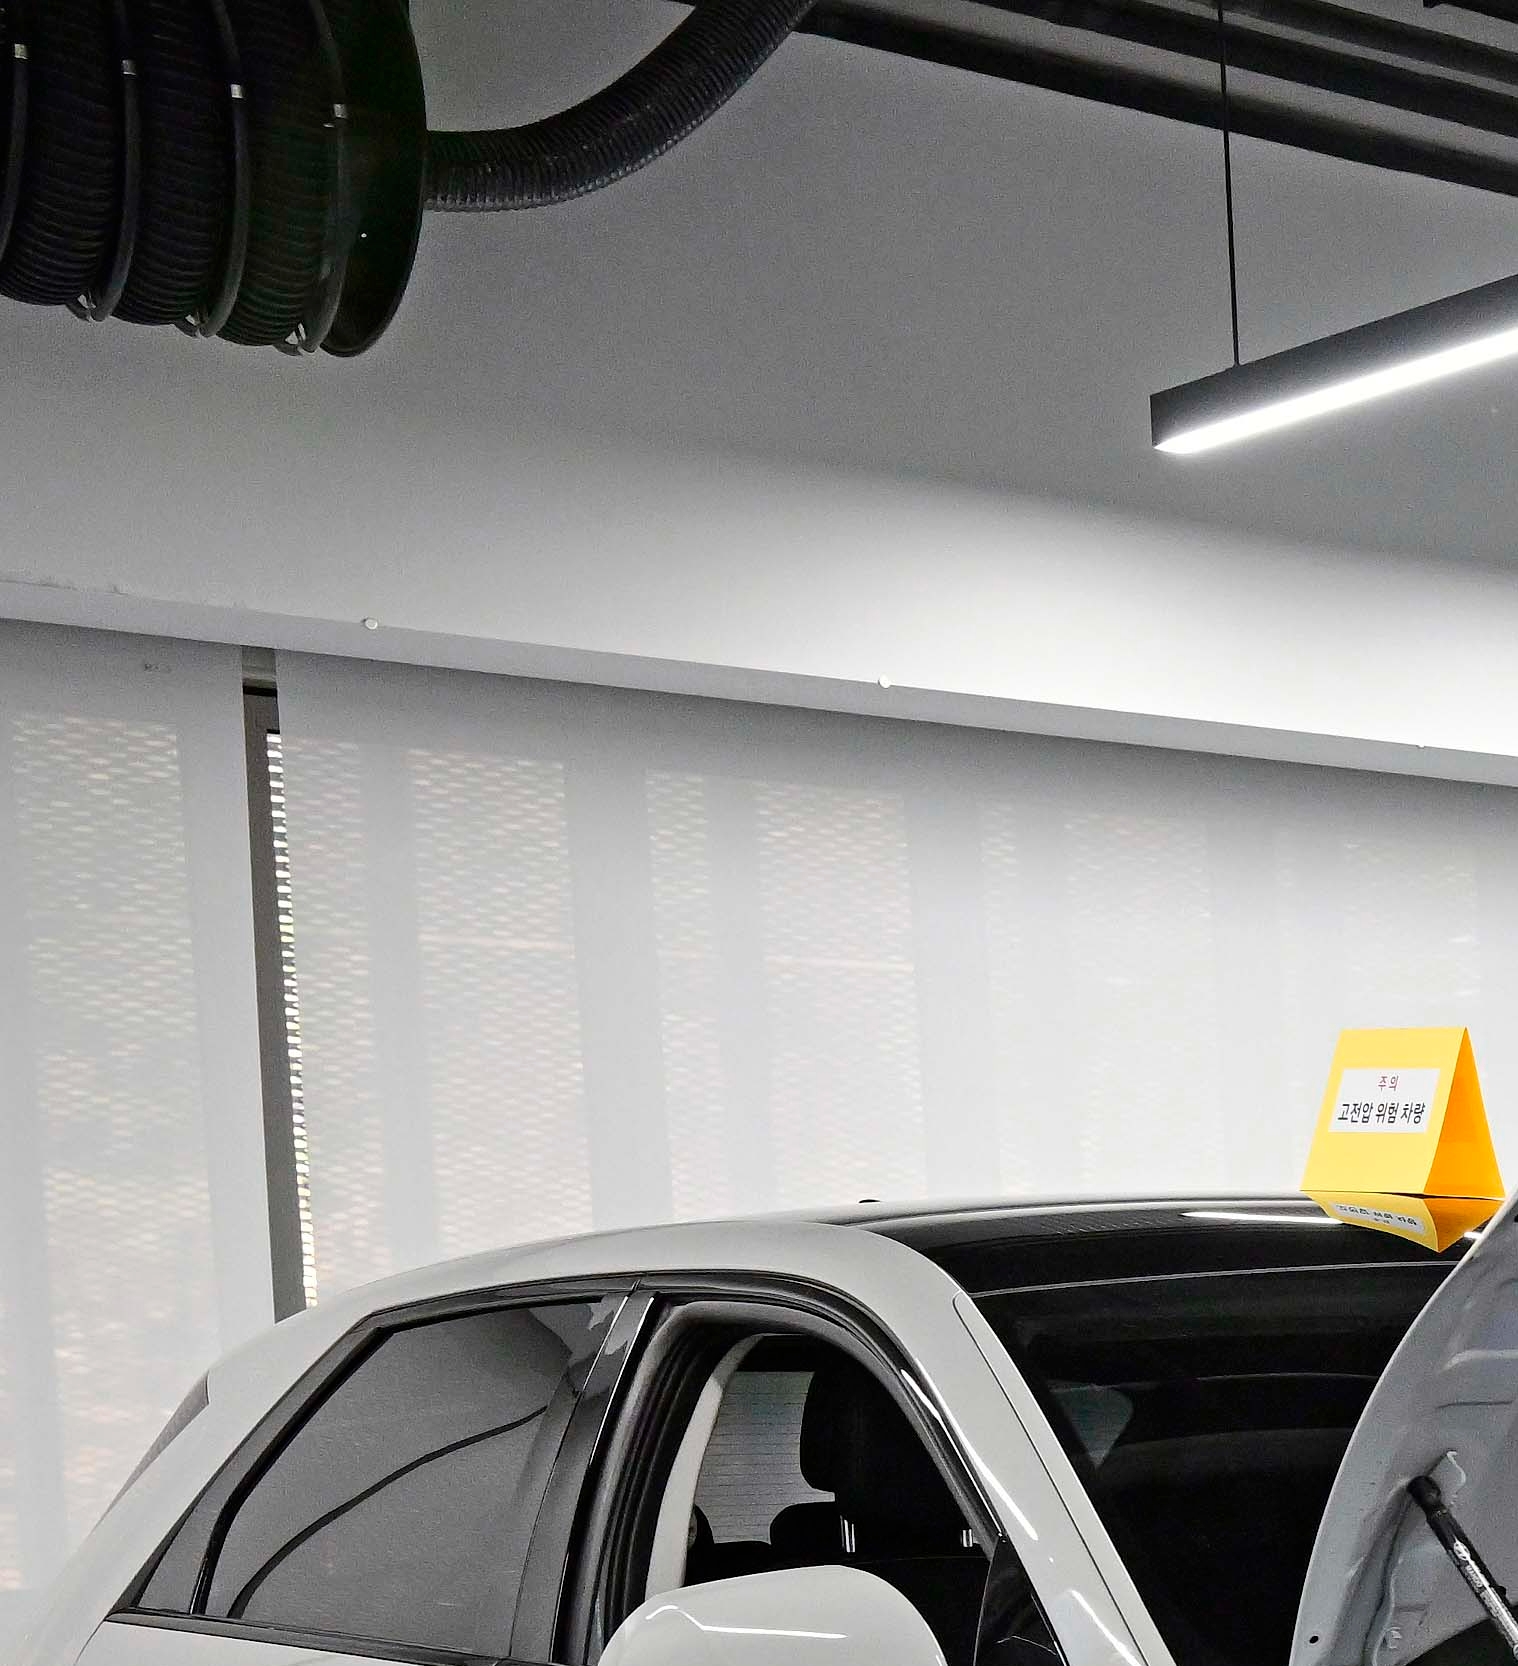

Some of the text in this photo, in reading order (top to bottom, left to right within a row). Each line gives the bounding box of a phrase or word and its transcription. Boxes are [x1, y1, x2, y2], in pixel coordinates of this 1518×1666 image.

[1337, 1101, 1426, 1124] 고전압 위험 차량
